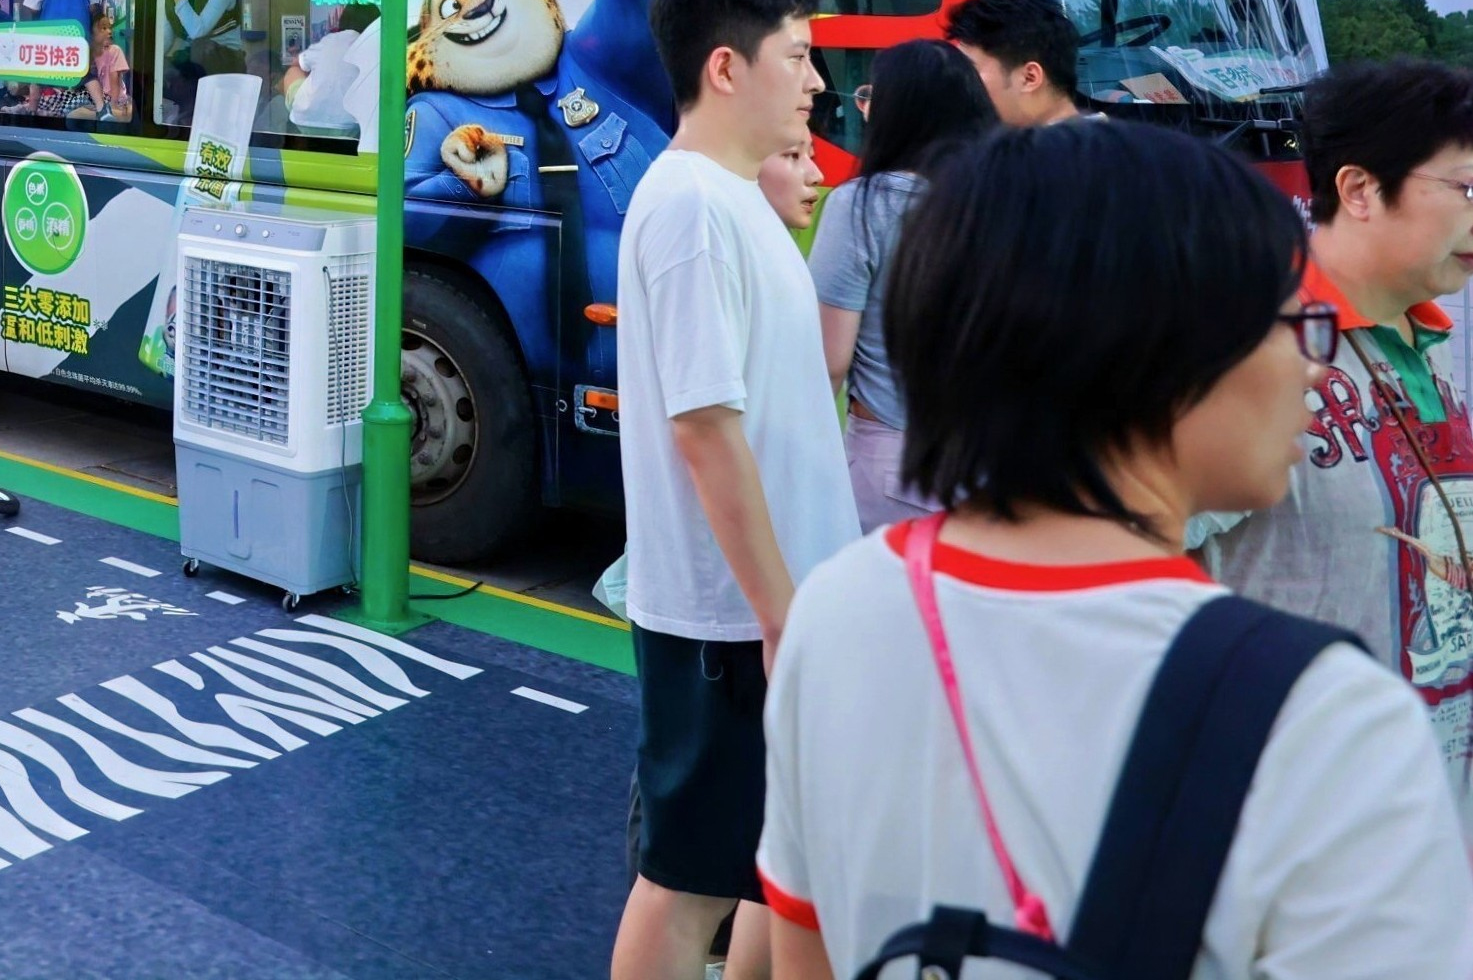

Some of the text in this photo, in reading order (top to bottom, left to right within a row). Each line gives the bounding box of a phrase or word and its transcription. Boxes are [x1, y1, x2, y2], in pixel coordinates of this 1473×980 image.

[19, 44, 80, 67] 叮当快药
[200, 141, 232, 173] 有效
[4, 285, 90, 325] 三大零添加
[1, 315, 89, 355] 温和低刺激
